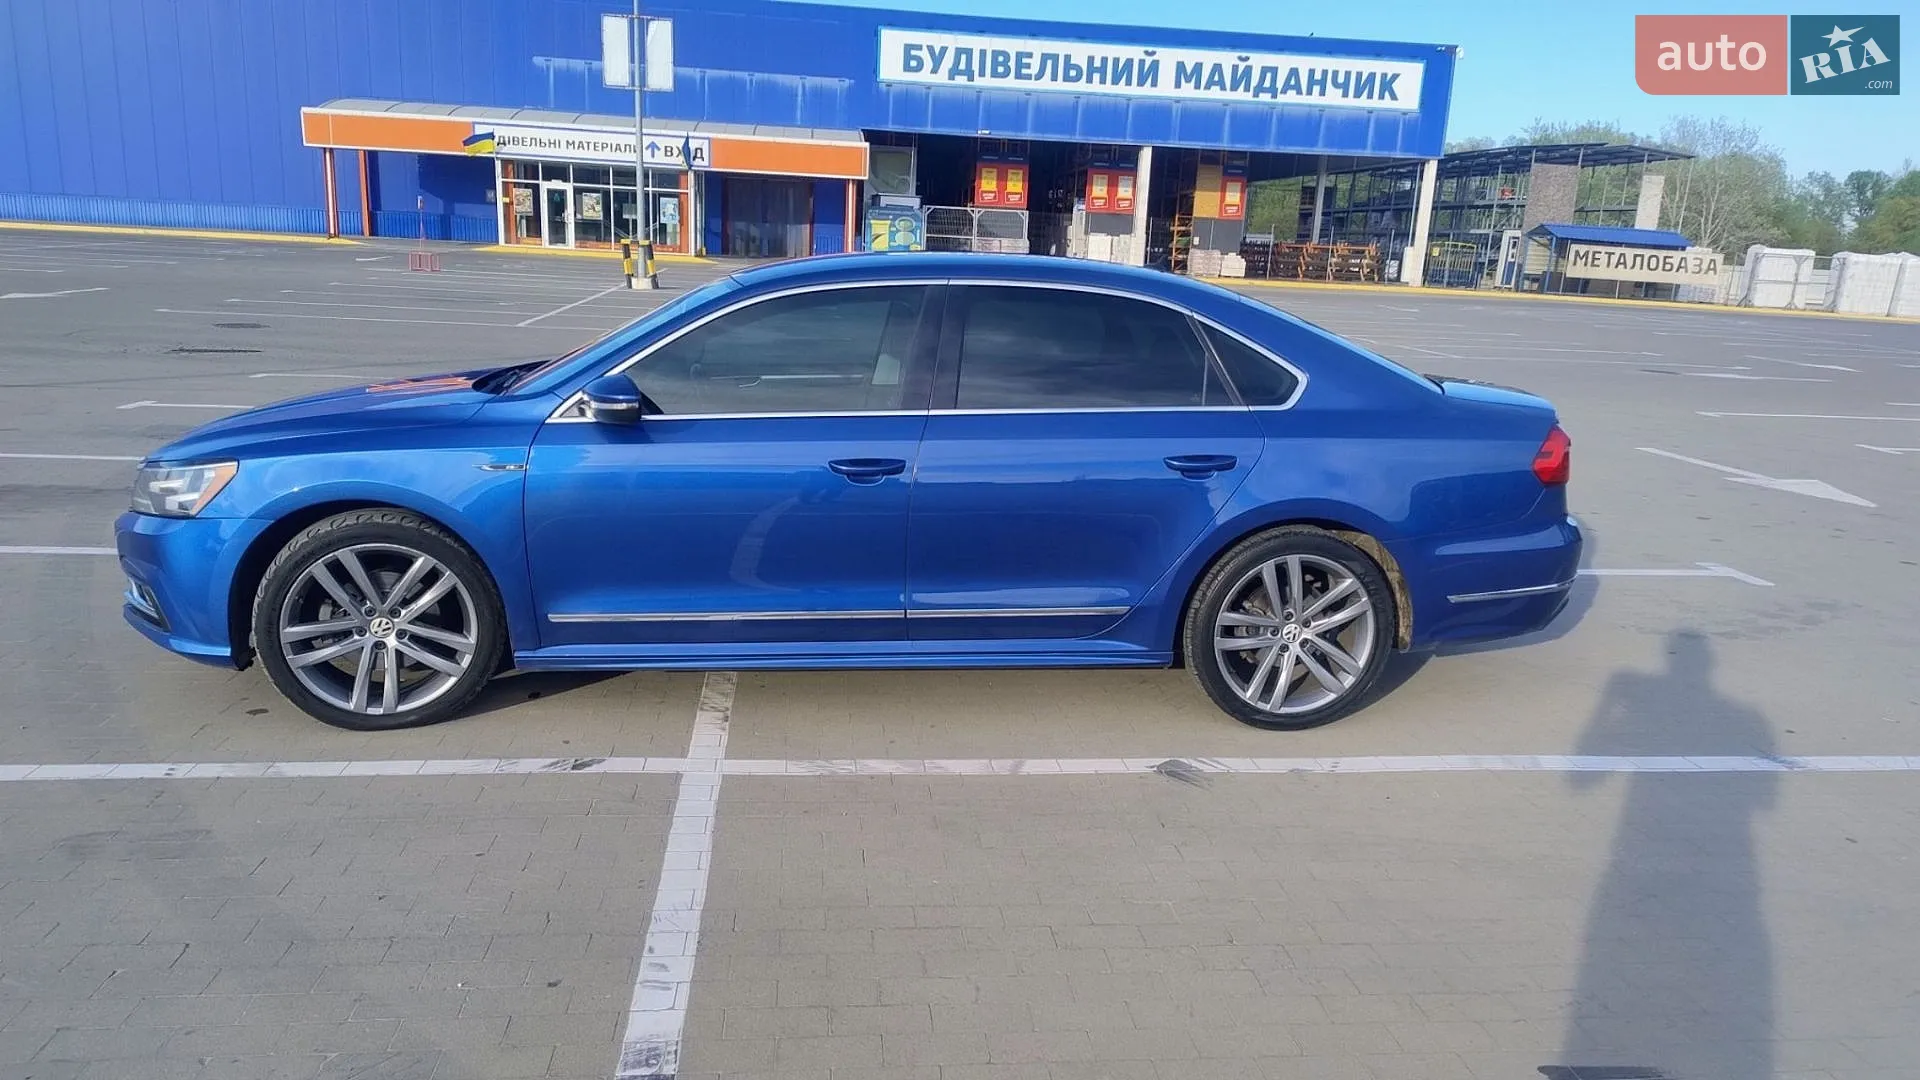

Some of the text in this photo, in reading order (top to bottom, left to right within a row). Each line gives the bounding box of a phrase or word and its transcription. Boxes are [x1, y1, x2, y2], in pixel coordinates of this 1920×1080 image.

[902, 42, 1402, 101] БУДІВЕЛЬНИЙ МАЙДАНЧИК
[496, 135, 561, 149] ДІВЕЛЬНІ
[1573, 249, 1718, 276] МЕТАЛОБАЗА
